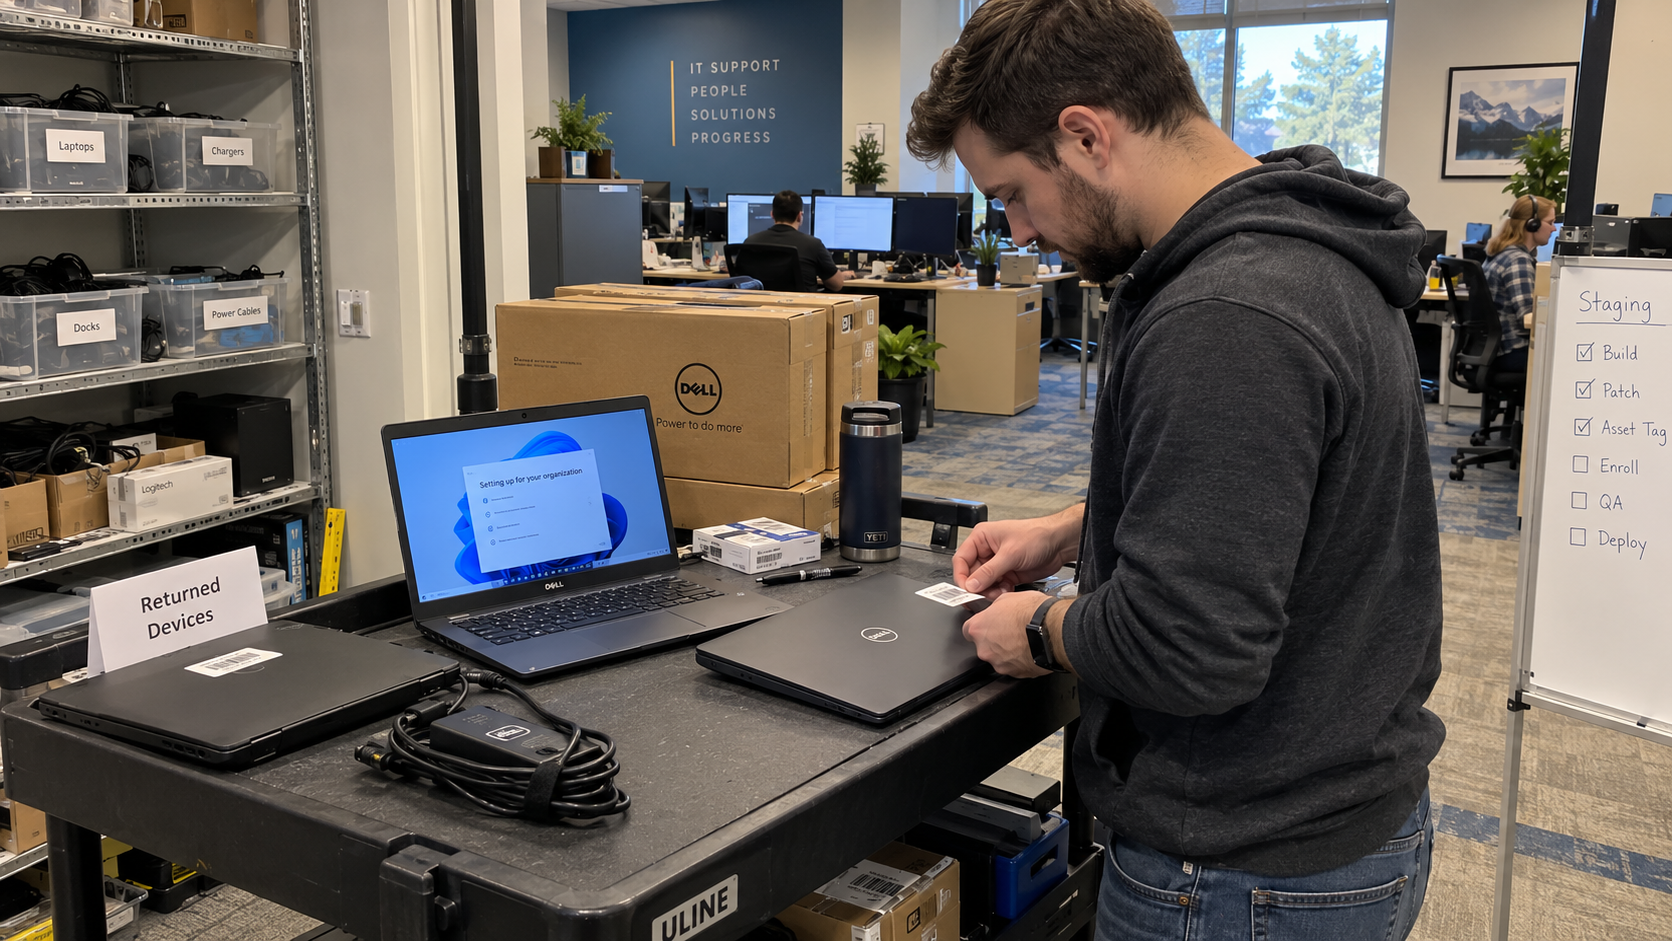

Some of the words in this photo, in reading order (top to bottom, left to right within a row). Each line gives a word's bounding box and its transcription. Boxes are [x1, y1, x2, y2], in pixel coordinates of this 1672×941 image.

[690, 62, 703, 75] IT
[710, 59, 780, 74] SUPPORT
[691, 84, 747, 98] PEOPLE
[691, 107, 776, 121] SOLUTIONS
[691, 131, 770, 144] PROGRESS
[59, 141, 95, 153] Laptops
[211, 146, 245, 157] Chargers
[212, 309, 236, 319] Power
[237, 306, 261, 316] Cables
[1579, 290, 1651, 323] Staging
[74, 322, 101, 333] Docks
[1603, 344, 1638, 361] Build
[680, 382, 717, 396] DELL
[1603, 382, 1640, 399] Patch
[656, 417, 686, 429] Power
[689, 420, 699, 430] to
[700, 420, 715, 431] do
[717, 424, 742, 433] more
[1601, 420, 1636, 436] Asset
[1642, 421, 1667, 446] Tag
[1601, 458, 1639, 475] Enroll
[479, 479, 505, 489] Setting
[505, 478, 515, 486] up
[515, 475, 525, 484] for
[526, 474, 541, 483] your
[542, 467, 583, 480] organization
[142, 480, 174, 494] Logitech
[1599, 493, 1623, 510] QA
[866, 533, 887, 542] YETI
[1598, 529, 1647, 560] Deploy
[545, 581, 565, 590] DELL
[141, 576, 221, 613] Returned
[148, 609, 214, 639] Devices
[662, 885, 728, 941] ULINE
